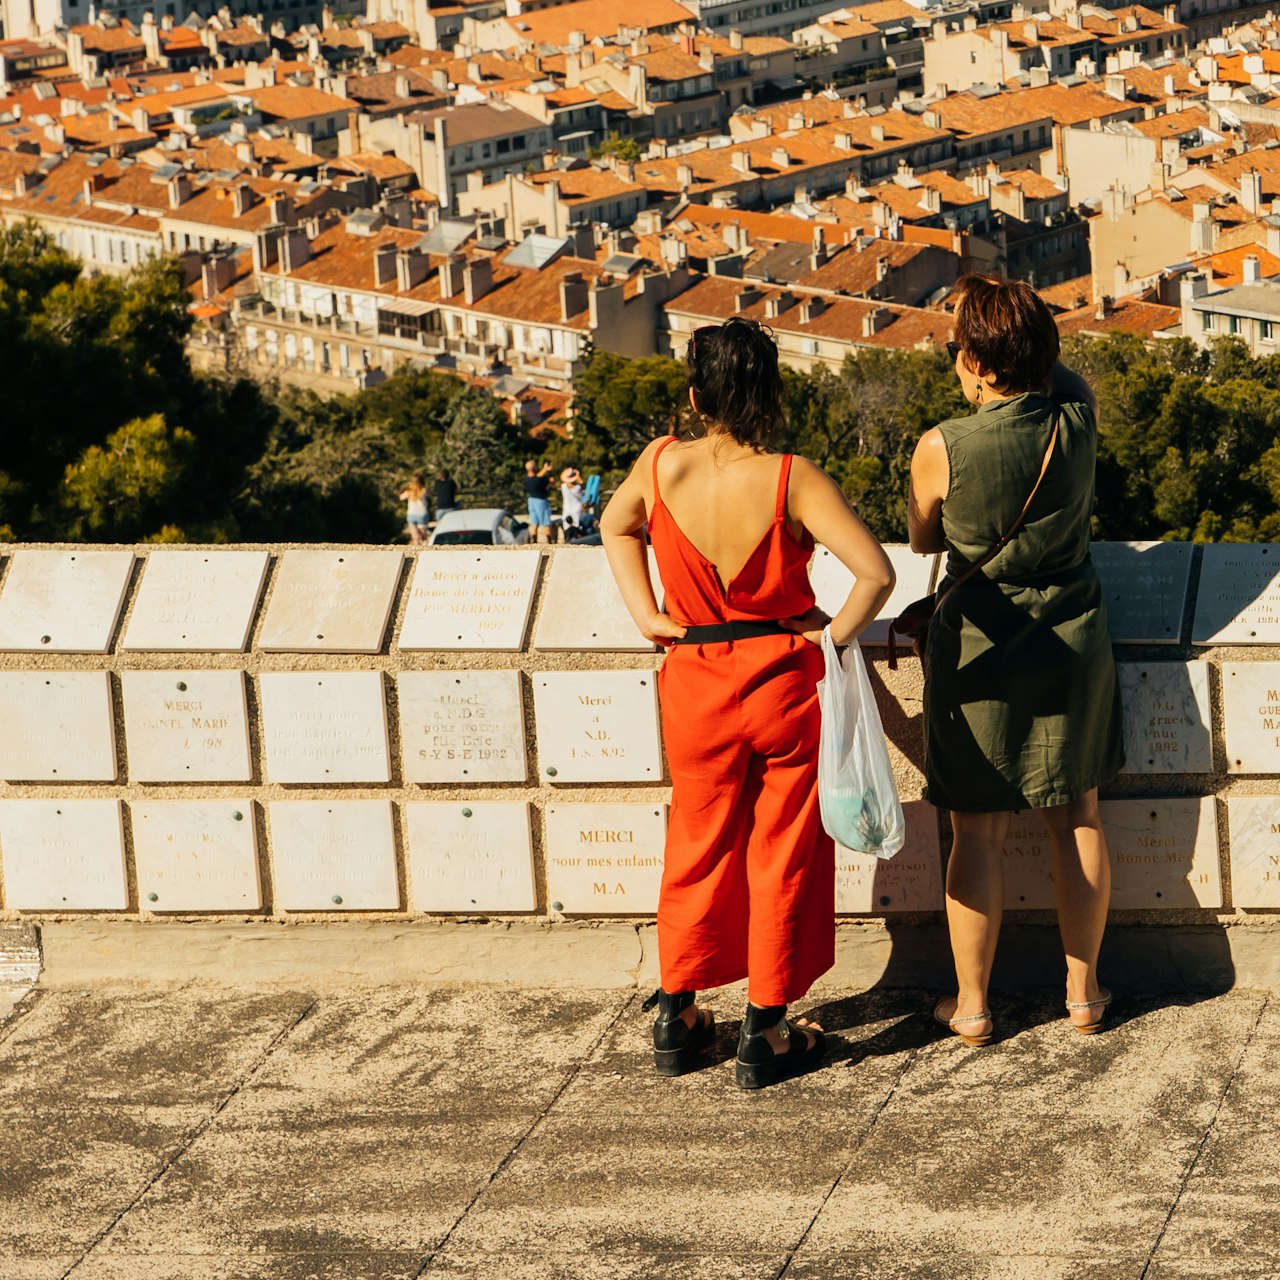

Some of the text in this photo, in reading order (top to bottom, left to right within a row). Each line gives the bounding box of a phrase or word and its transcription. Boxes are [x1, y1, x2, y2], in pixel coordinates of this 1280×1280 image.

[579, 831, 635, 843] MERCI
[587, 858, 613, 867] mes
[1116, 853, 1159, 863] Bonne
